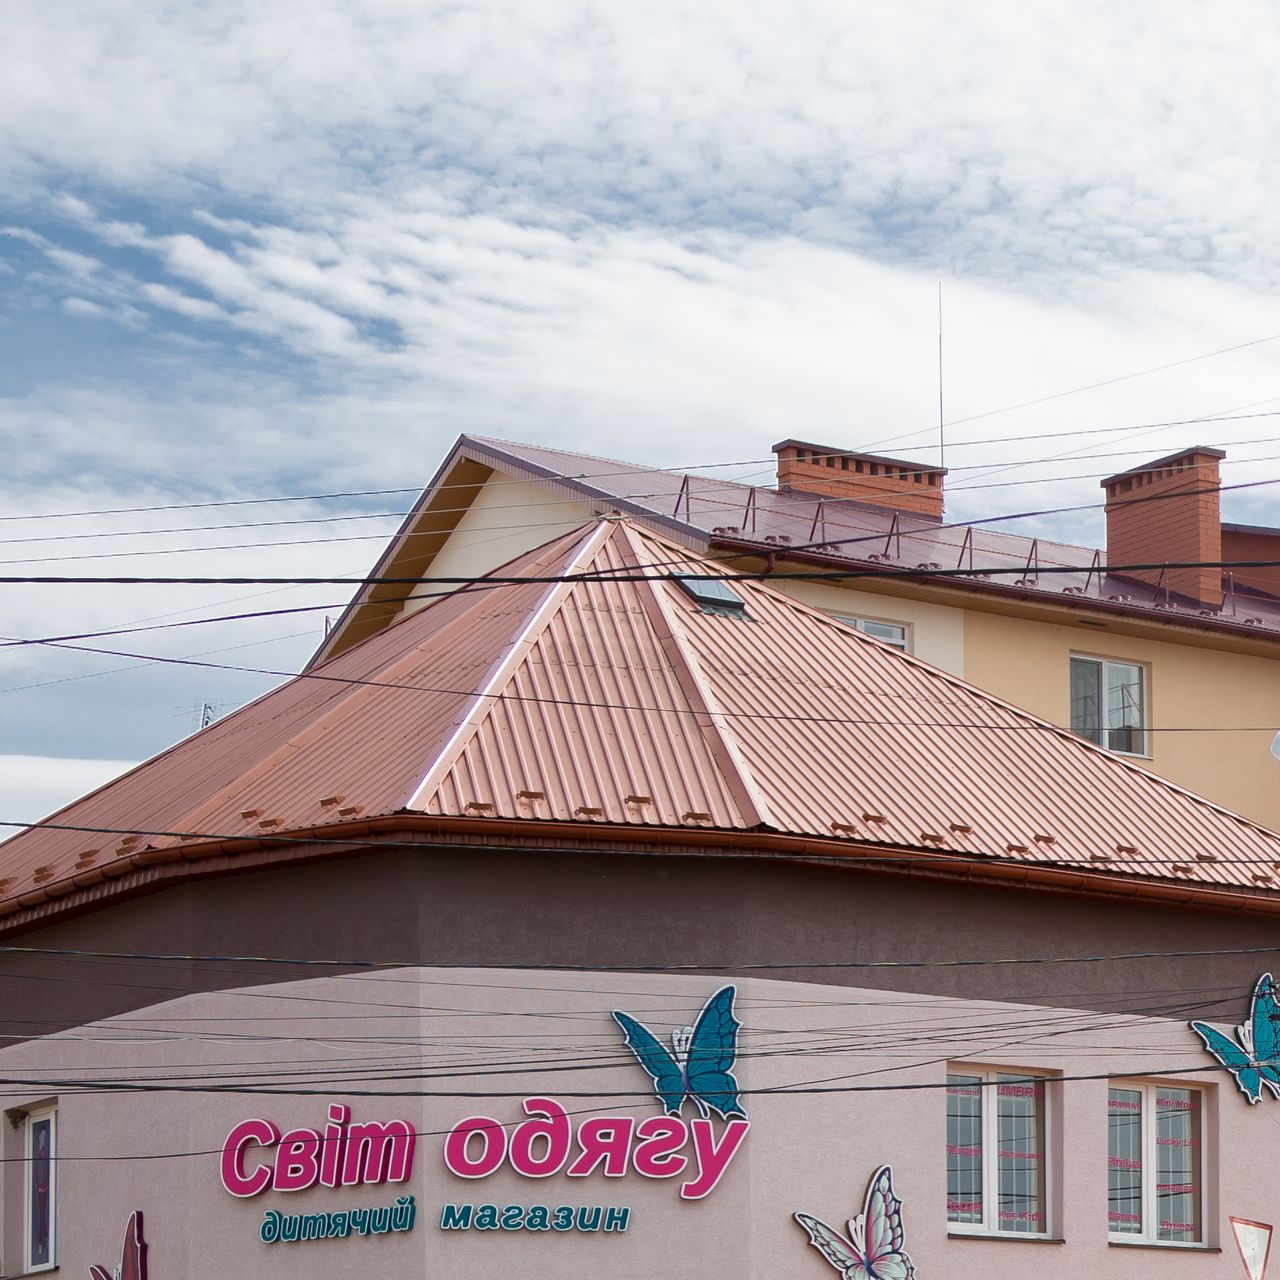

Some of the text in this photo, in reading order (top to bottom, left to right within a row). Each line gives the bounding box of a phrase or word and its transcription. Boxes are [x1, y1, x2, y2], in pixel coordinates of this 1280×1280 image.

[220, 1097, 751, 1200] Світ одягу
[259, 1195, 631, 1243] дитячий магазин
